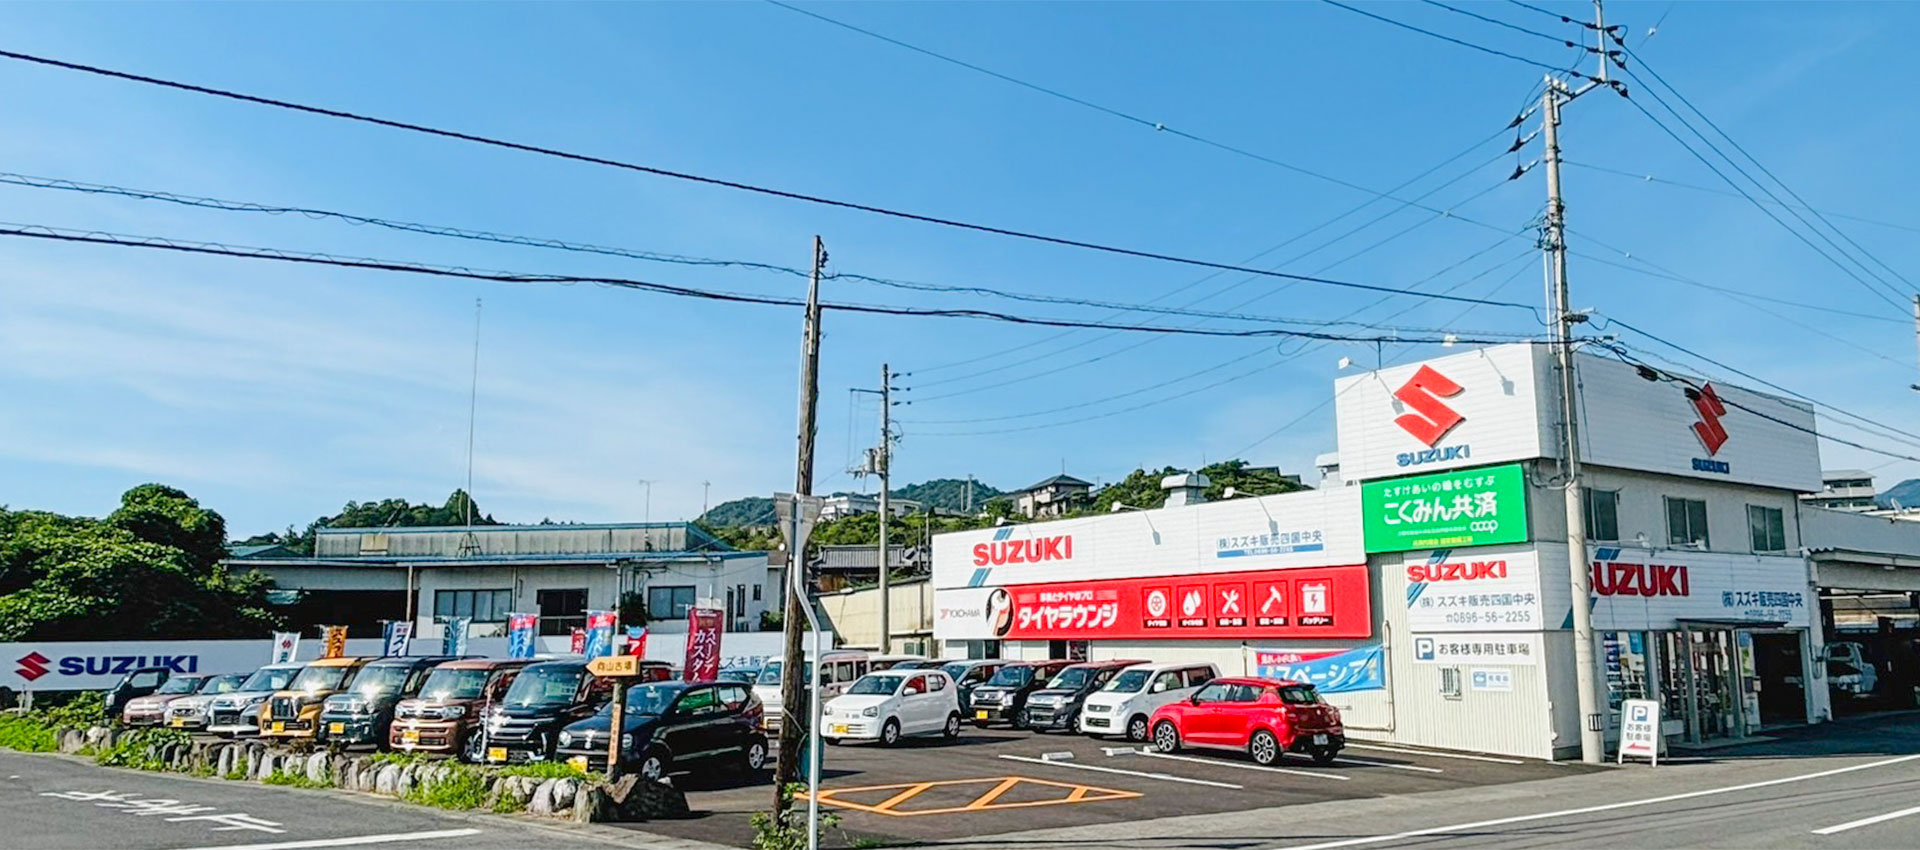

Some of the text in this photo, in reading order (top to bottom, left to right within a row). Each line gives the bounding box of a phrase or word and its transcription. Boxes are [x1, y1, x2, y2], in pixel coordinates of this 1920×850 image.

[1396, 445, 1471, 467] SUZUKI
[1691, 457, 1730, 474] SUZUKI
[1384, 491, 1497, 525] こくみん共済
[973, 535, 1072, 566] SUZUKI
[1407, 560, 1507, 583] SUZUKI
[1018, 603, 1117, 629] タイヤラウンジ
[1418, 639, 1433, 659] P
[1439, 643, 1530, 655] お客様専用駐車場
[58, 655, 198, 676] SUZUKI
